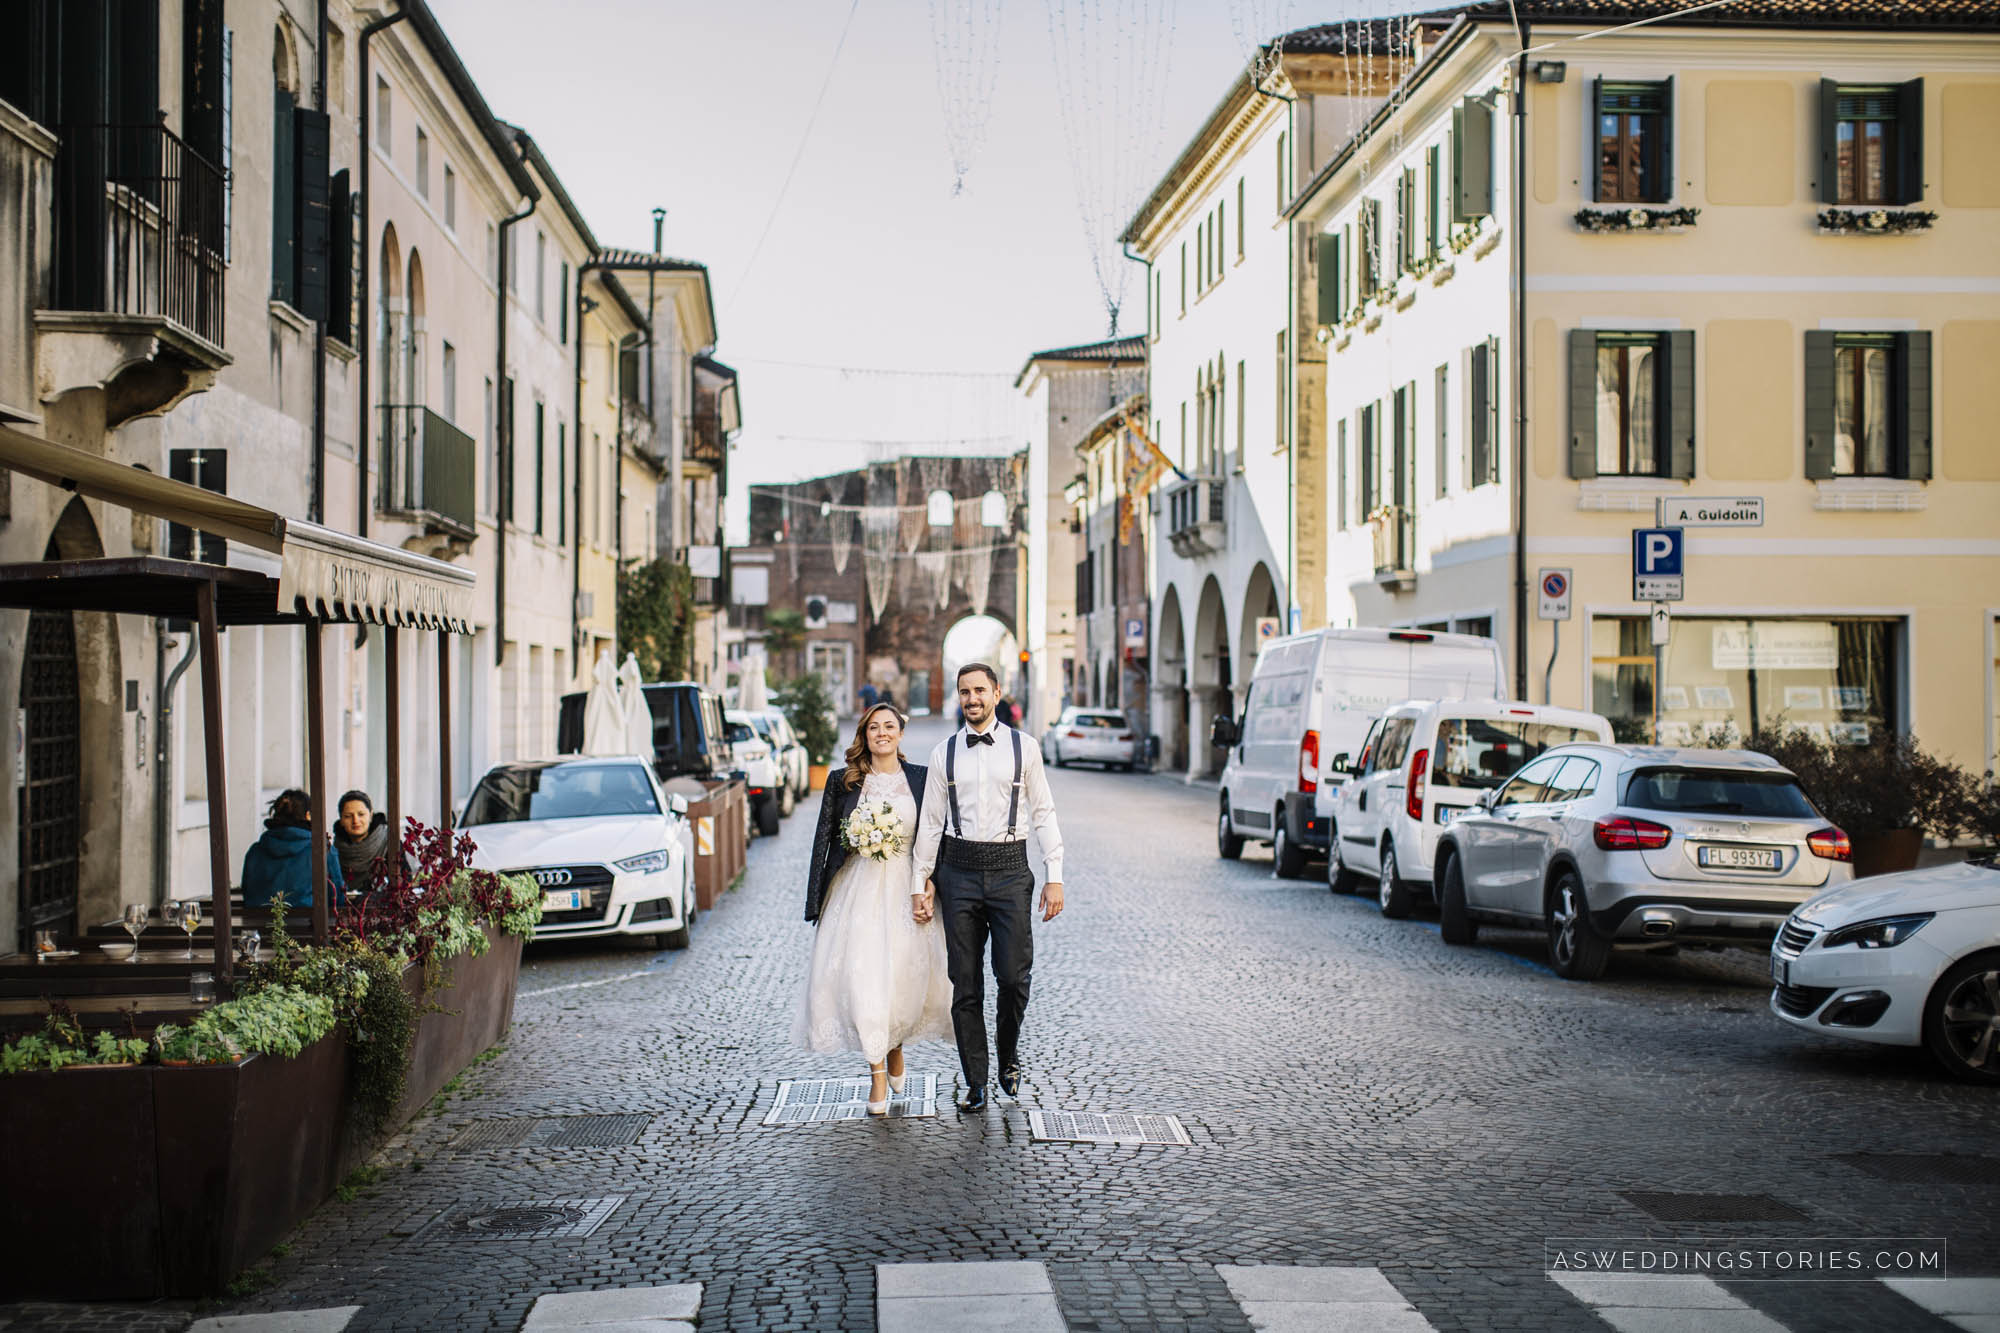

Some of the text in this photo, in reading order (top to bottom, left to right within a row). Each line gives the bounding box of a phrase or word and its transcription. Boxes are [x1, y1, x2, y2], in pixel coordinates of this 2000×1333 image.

[1679, 509, 1758, 520] A. Guidolin
[1646, 533, 1673, 571] P
[1128, 621, 1142, 636] P
[1710, 849, 1773, 866] FL 993YZ
